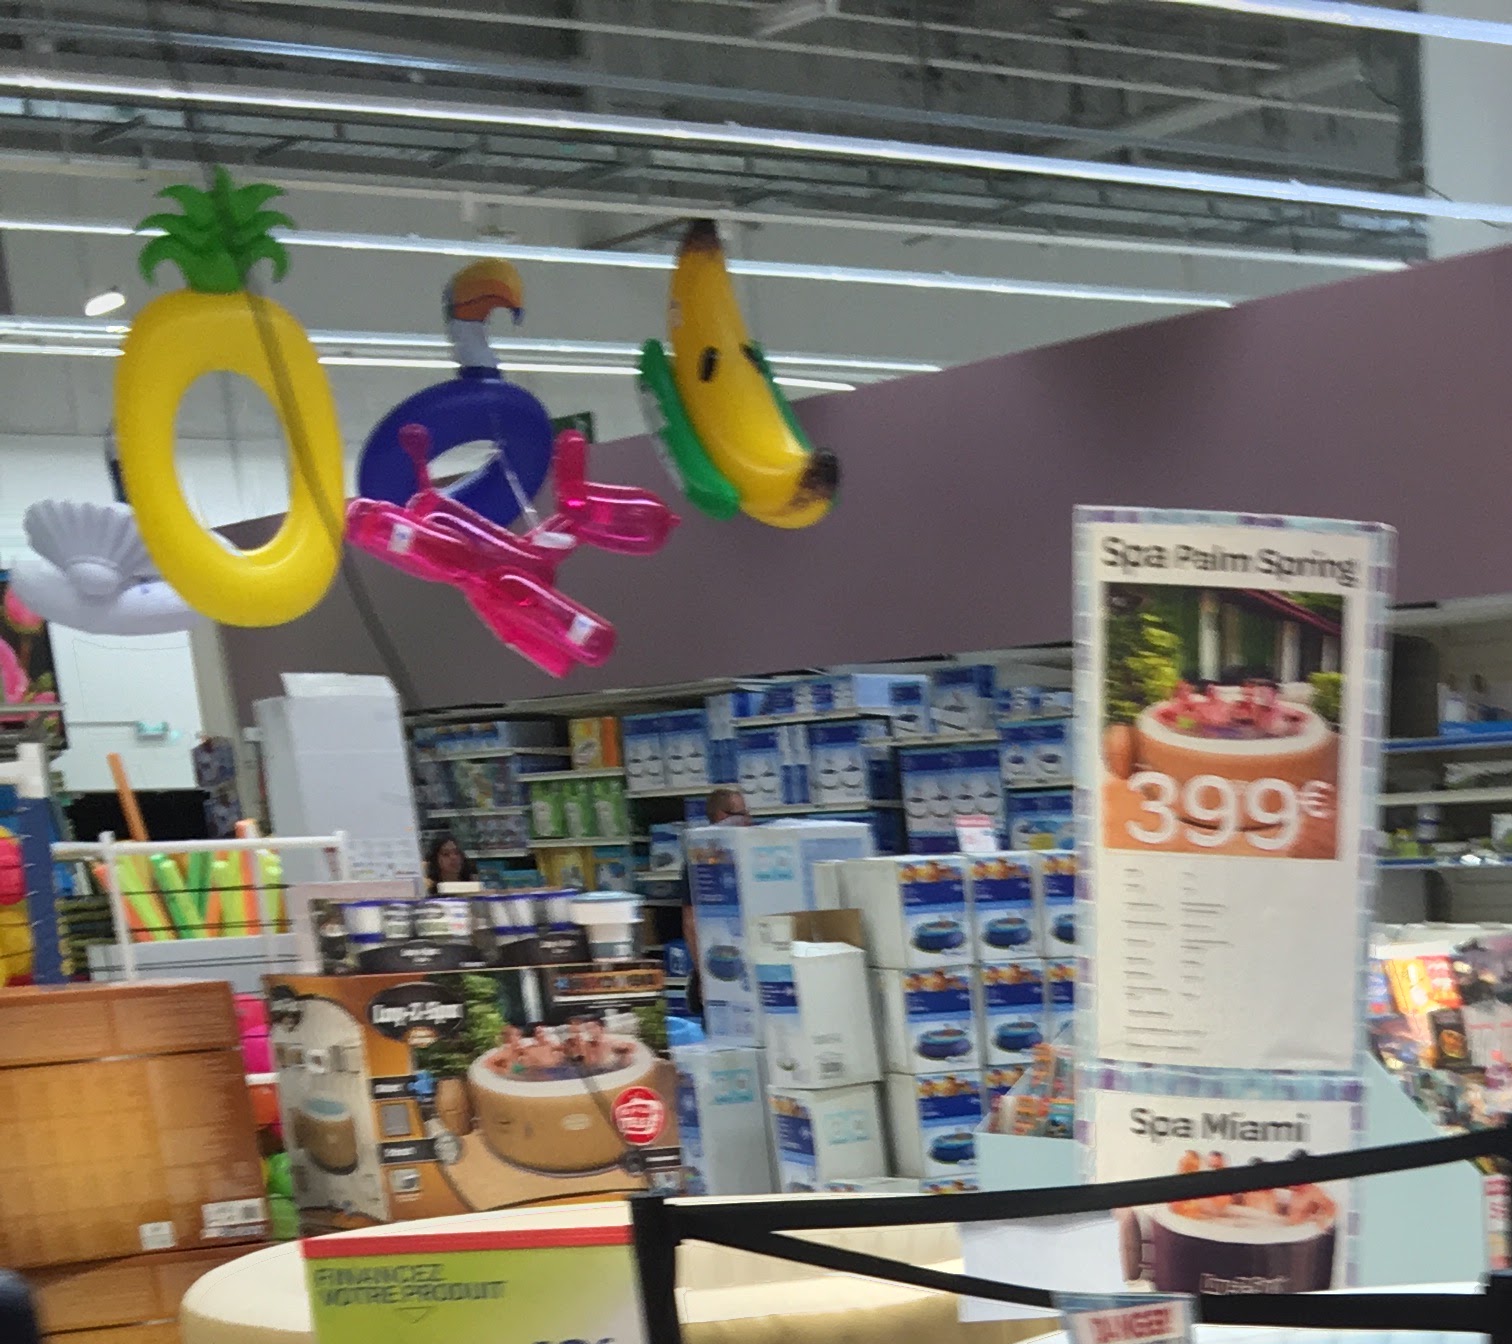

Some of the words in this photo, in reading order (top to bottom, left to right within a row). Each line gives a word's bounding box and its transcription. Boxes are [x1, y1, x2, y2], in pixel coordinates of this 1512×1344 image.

[1101, 536, 1168, 575] Spa
[1175, 543, 1250, 572] Palm
[1125, 769, 1336, 851] 399€
[1129, 1107, 1193, 1143] Spa
[1200, 1111, 1310, 1143] Miami
